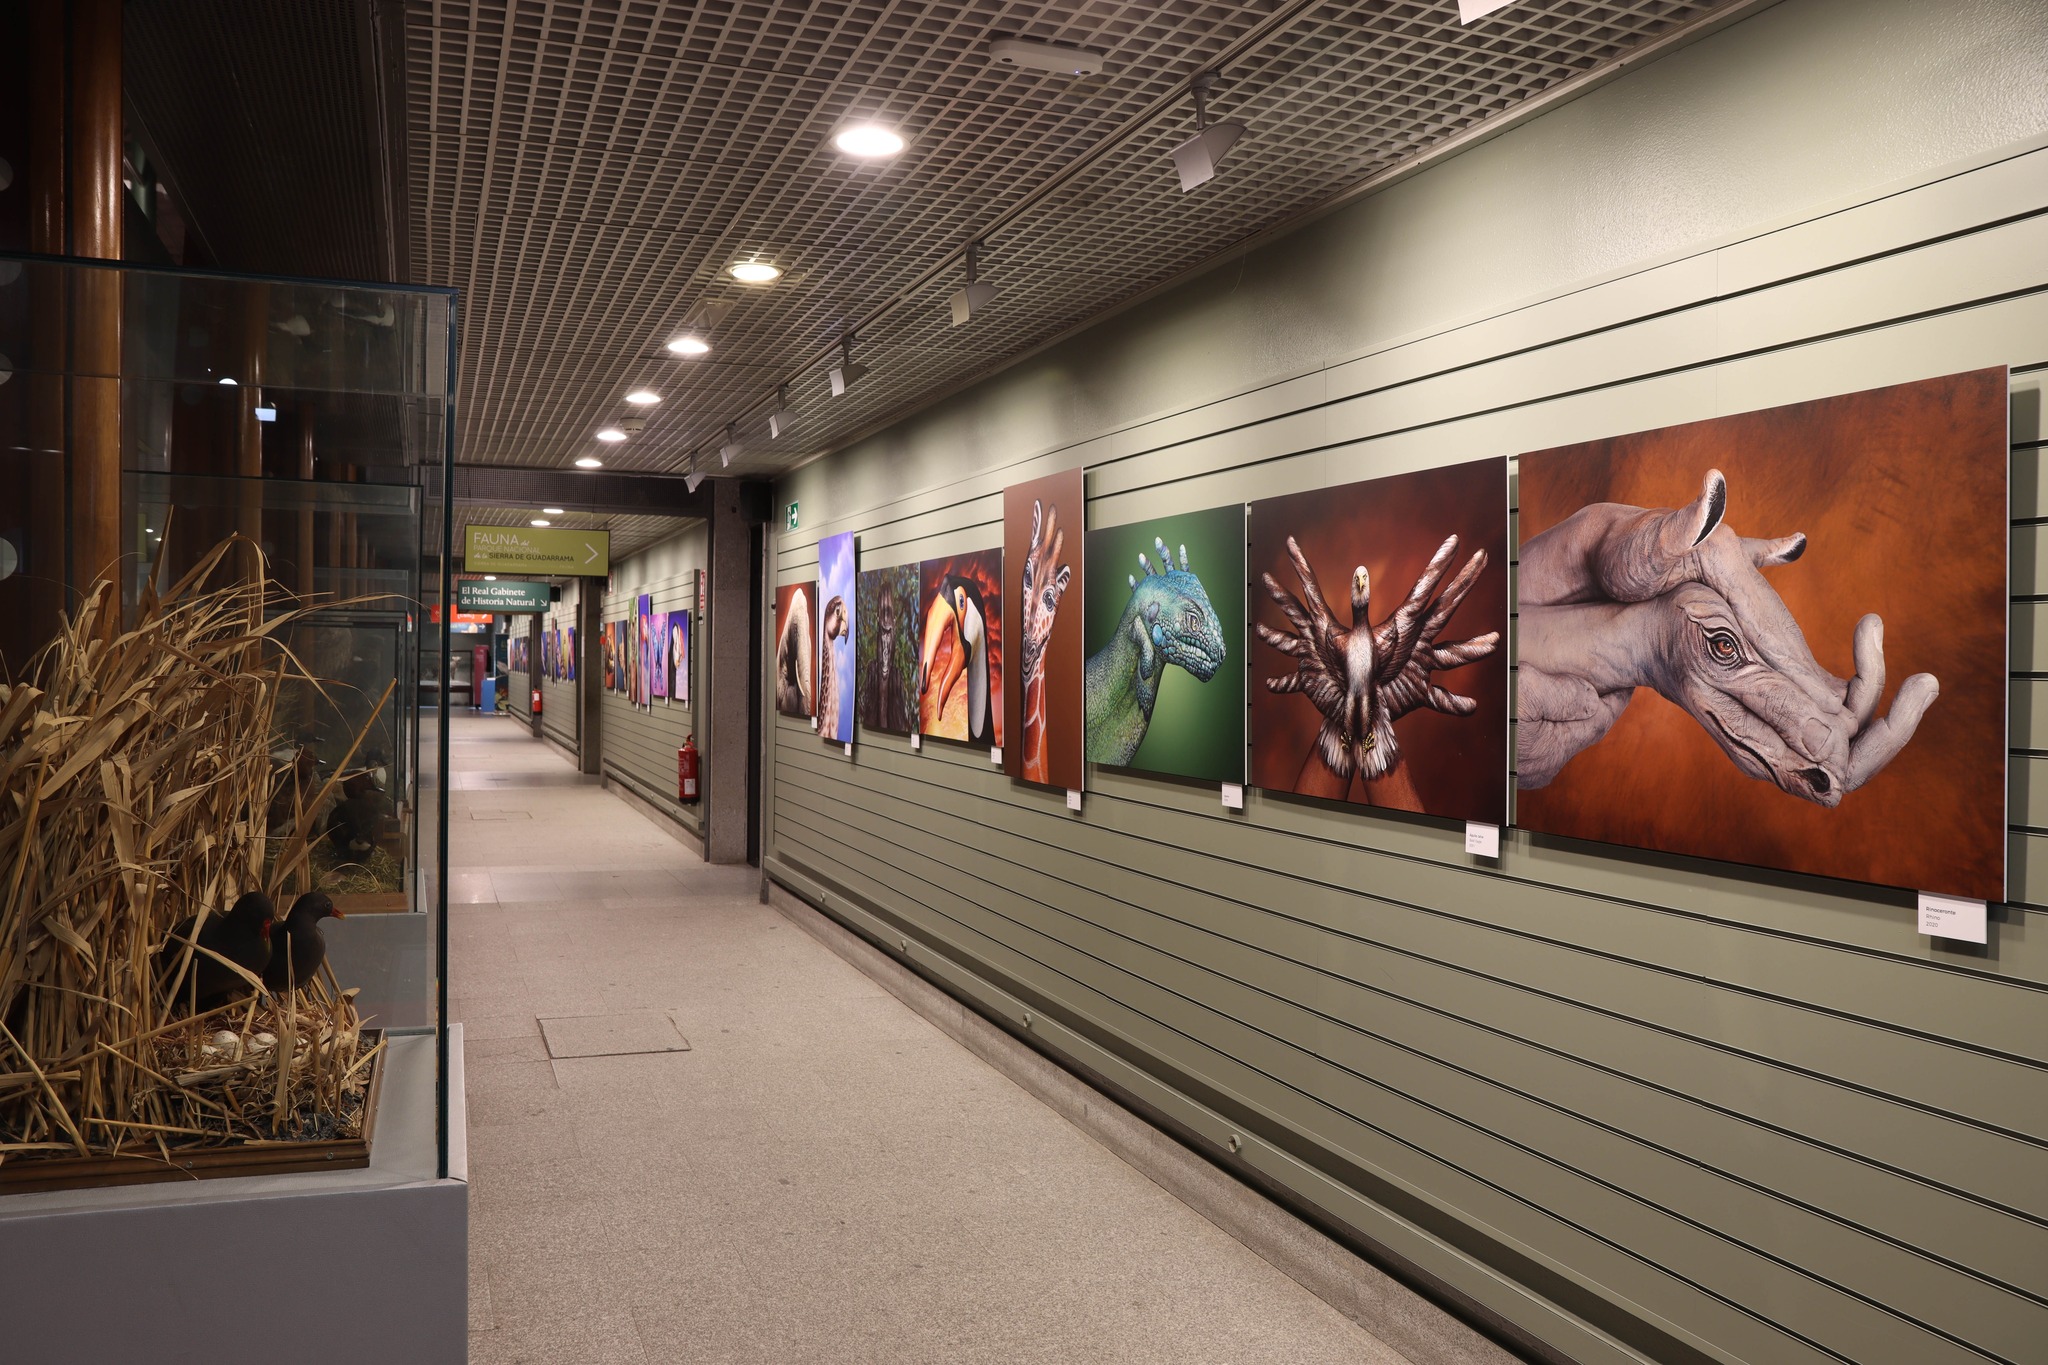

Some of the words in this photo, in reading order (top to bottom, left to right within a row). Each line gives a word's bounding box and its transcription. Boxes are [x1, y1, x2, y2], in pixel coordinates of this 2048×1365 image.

[473, 532, 519, 545] FAUNA
[488, 552, 514, 560] SIERRA
[526, 554, 575, 562] GUADARRAMA
[461, 586, 470, 595] El
[471, 587, 489, 595] Real
[490, 587, 526, 596] Gabinete
[461, 596, 471, 605] de
[472, 597, 504, 606] Historia
[506, 598, 536, 607] Natural
[1926, 907, 1956, 915] Rinoceronte
